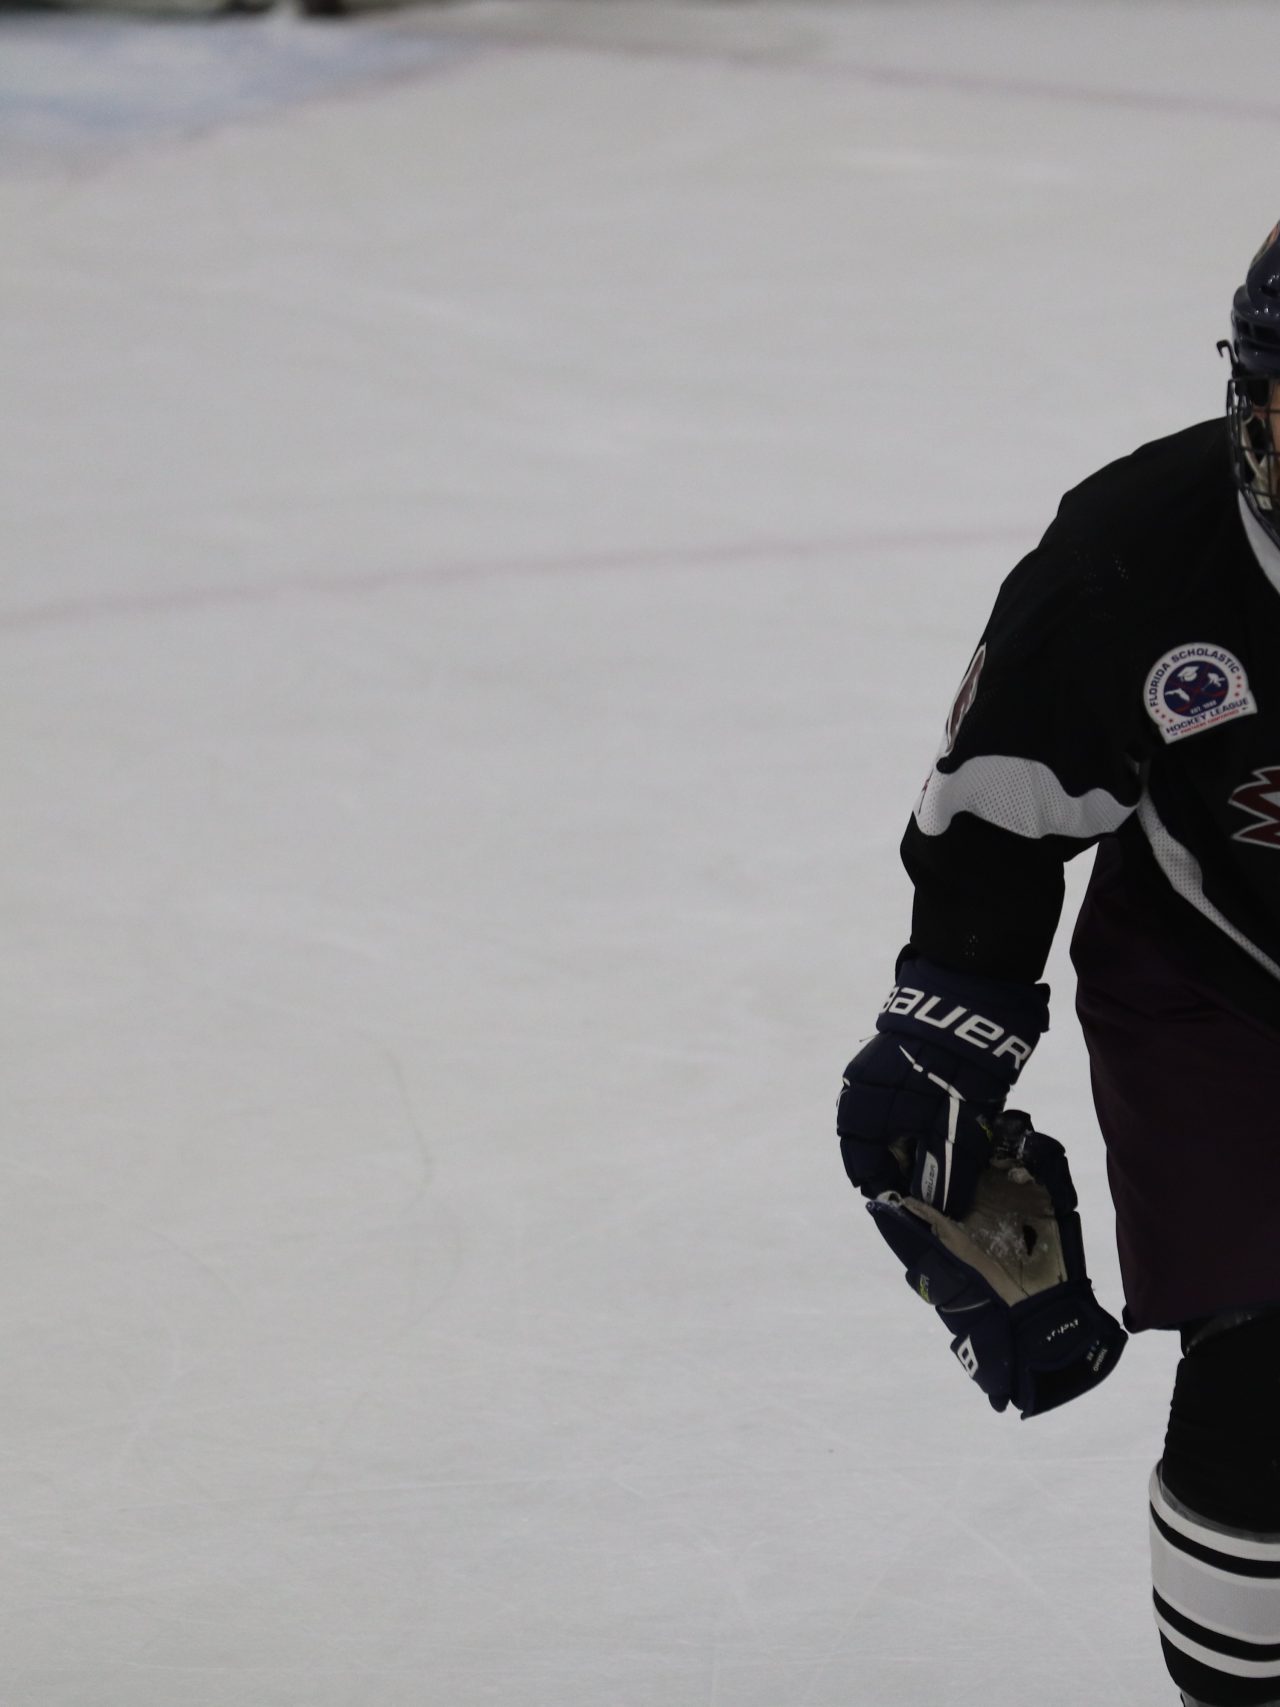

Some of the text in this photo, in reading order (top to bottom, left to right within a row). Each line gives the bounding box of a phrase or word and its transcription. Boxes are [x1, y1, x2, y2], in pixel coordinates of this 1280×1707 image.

[1149, 648, 1240, 707] FLORIDA SCHOLASTIC
[1166, 713, 1207, 734] HOCKEY
[1210, 697, 1248, 718] LEAGUE
